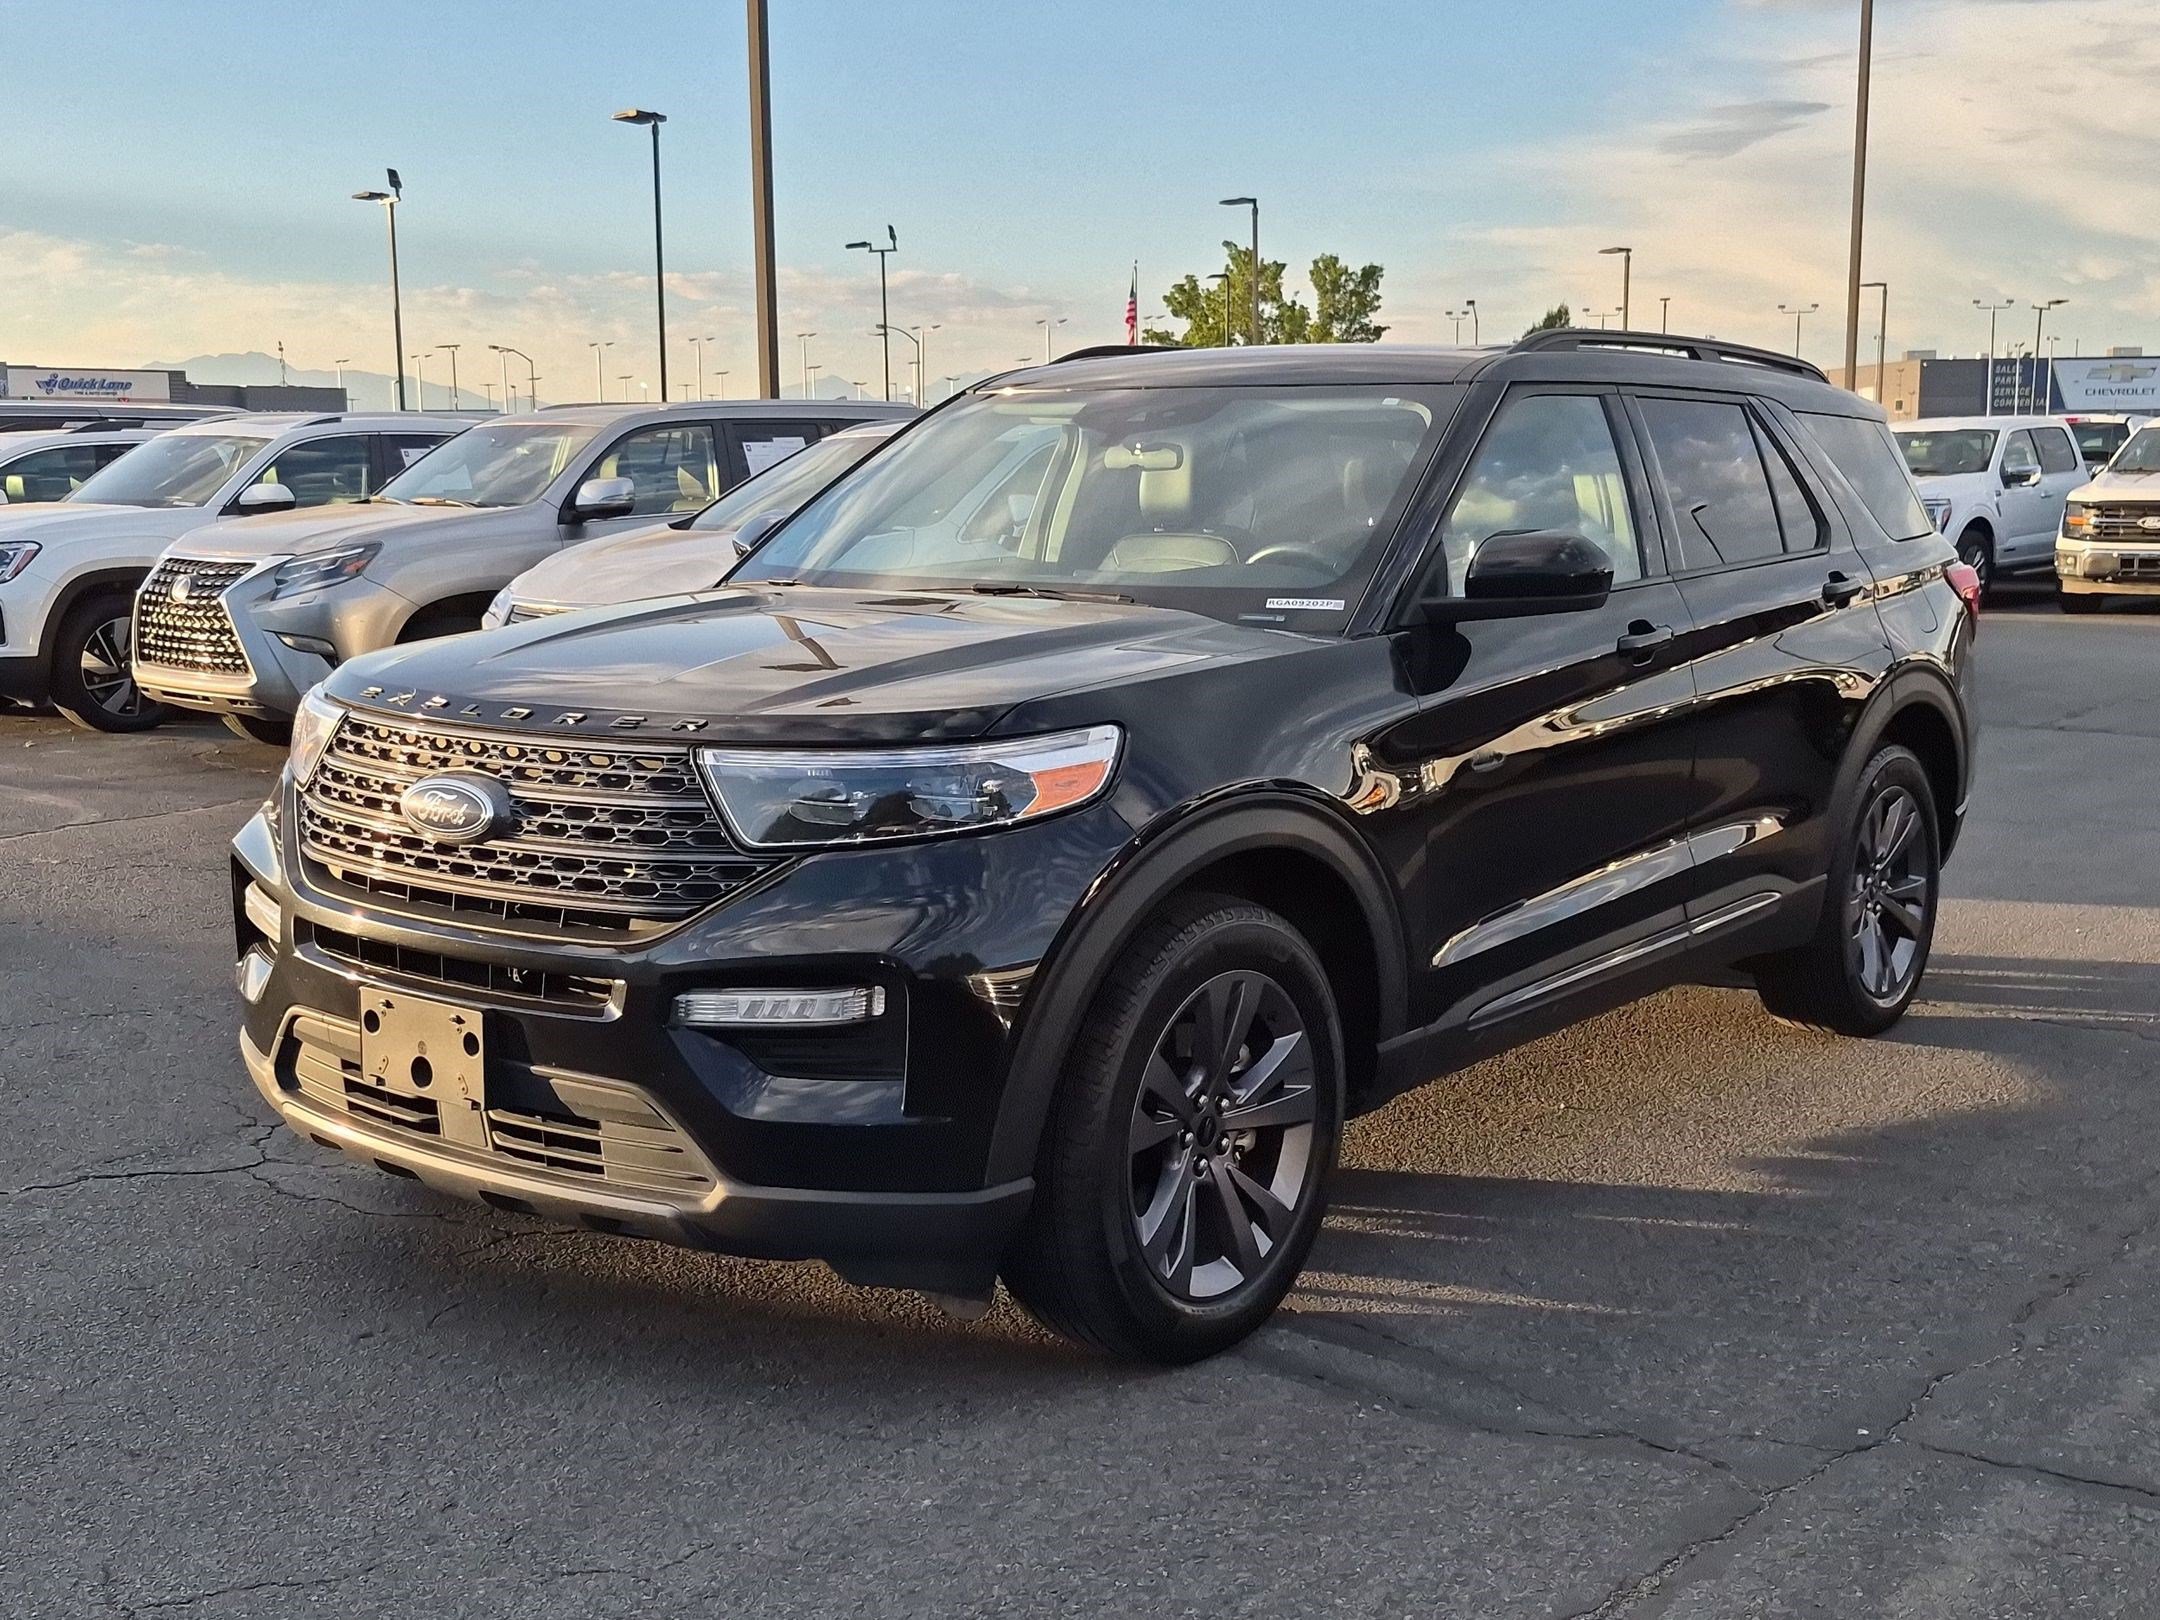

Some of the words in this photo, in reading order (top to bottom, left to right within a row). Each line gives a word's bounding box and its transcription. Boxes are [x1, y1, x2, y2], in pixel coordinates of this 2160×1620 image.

[58, 378, 97, 390] Quick
[99, 378, 133, 390] Lane
[1994, 387, 2031, 396] SERVCE
[2084, 387, 2157, 397] CHEVROLET
[359, 686, 710, 734] EXPLORER
[417, 790, 469, 826] Ford
